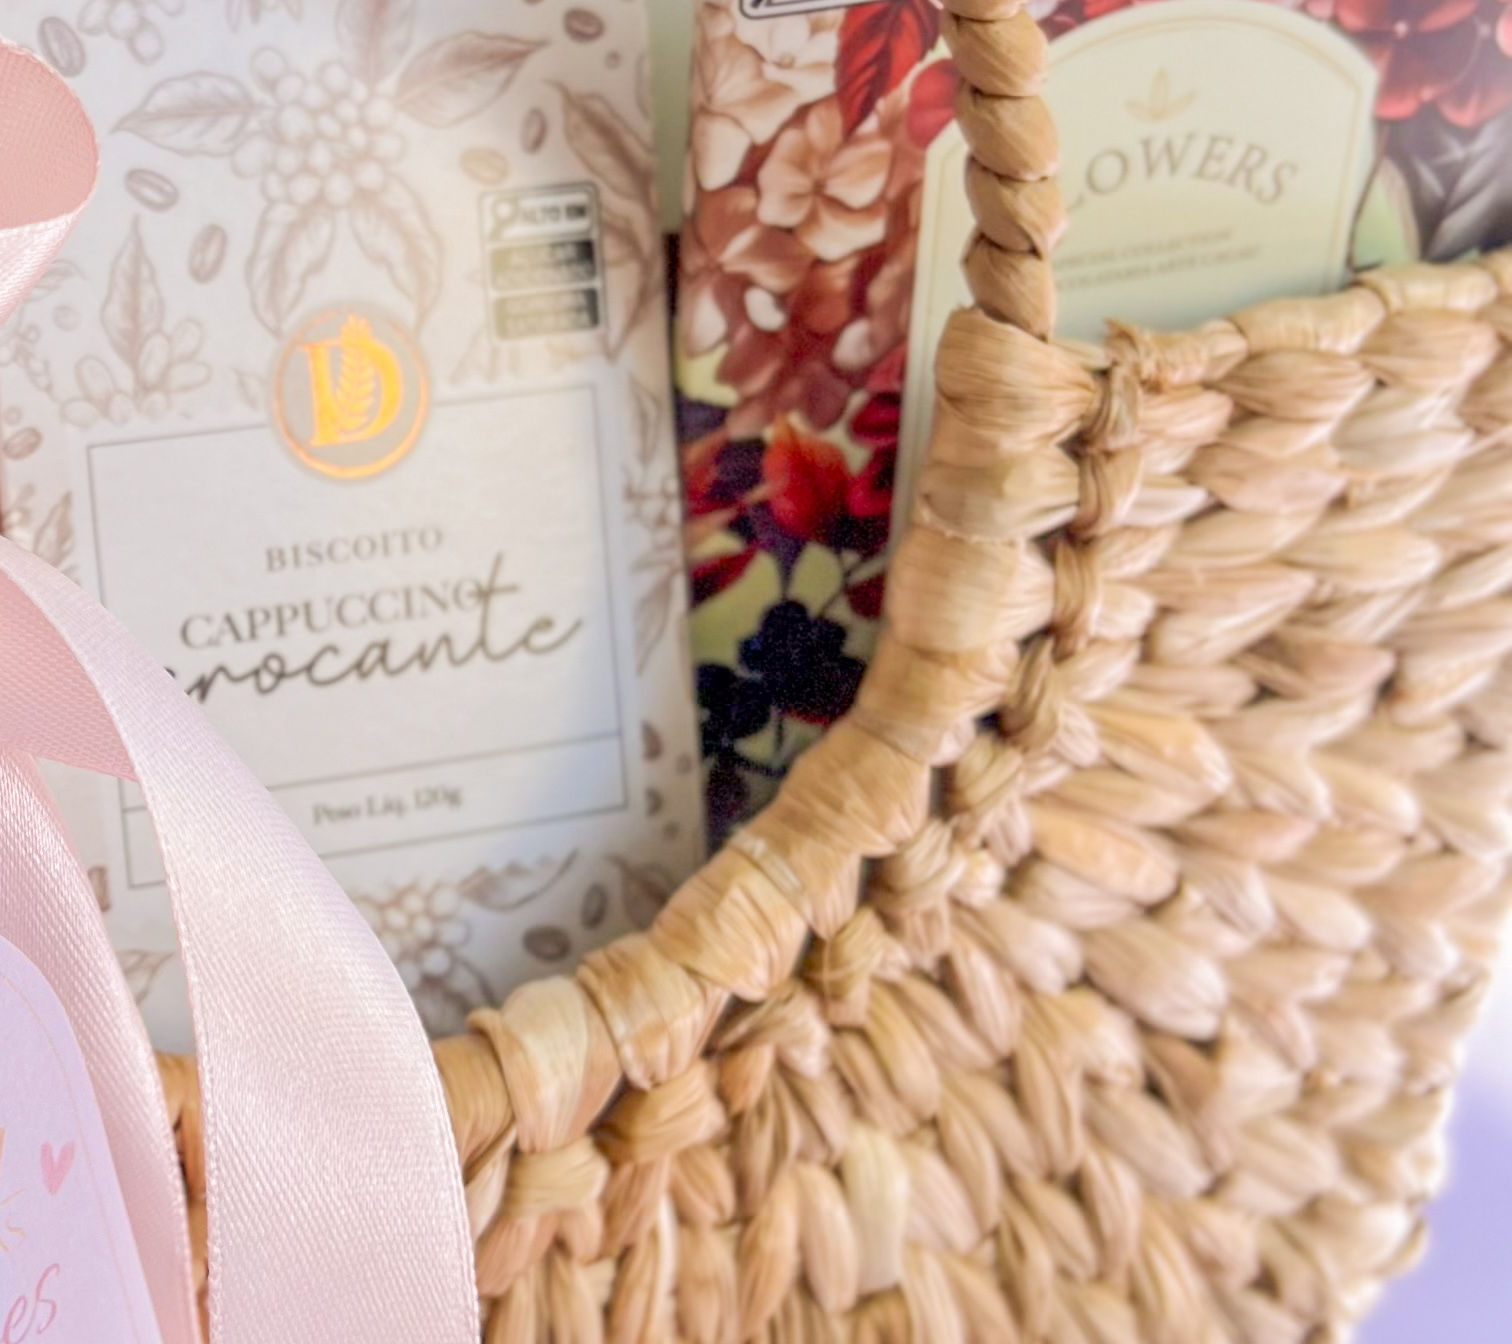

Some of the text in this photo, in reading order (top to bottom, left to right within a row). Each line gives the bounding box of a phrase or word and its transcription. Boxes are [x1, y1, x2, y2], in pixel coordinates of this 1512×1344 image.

[1066, 130, 1299, 207] OWERS
[264, 525, 445, 574] BISCOITO
[180, 576, 488, 651] CAPPUCCINO
